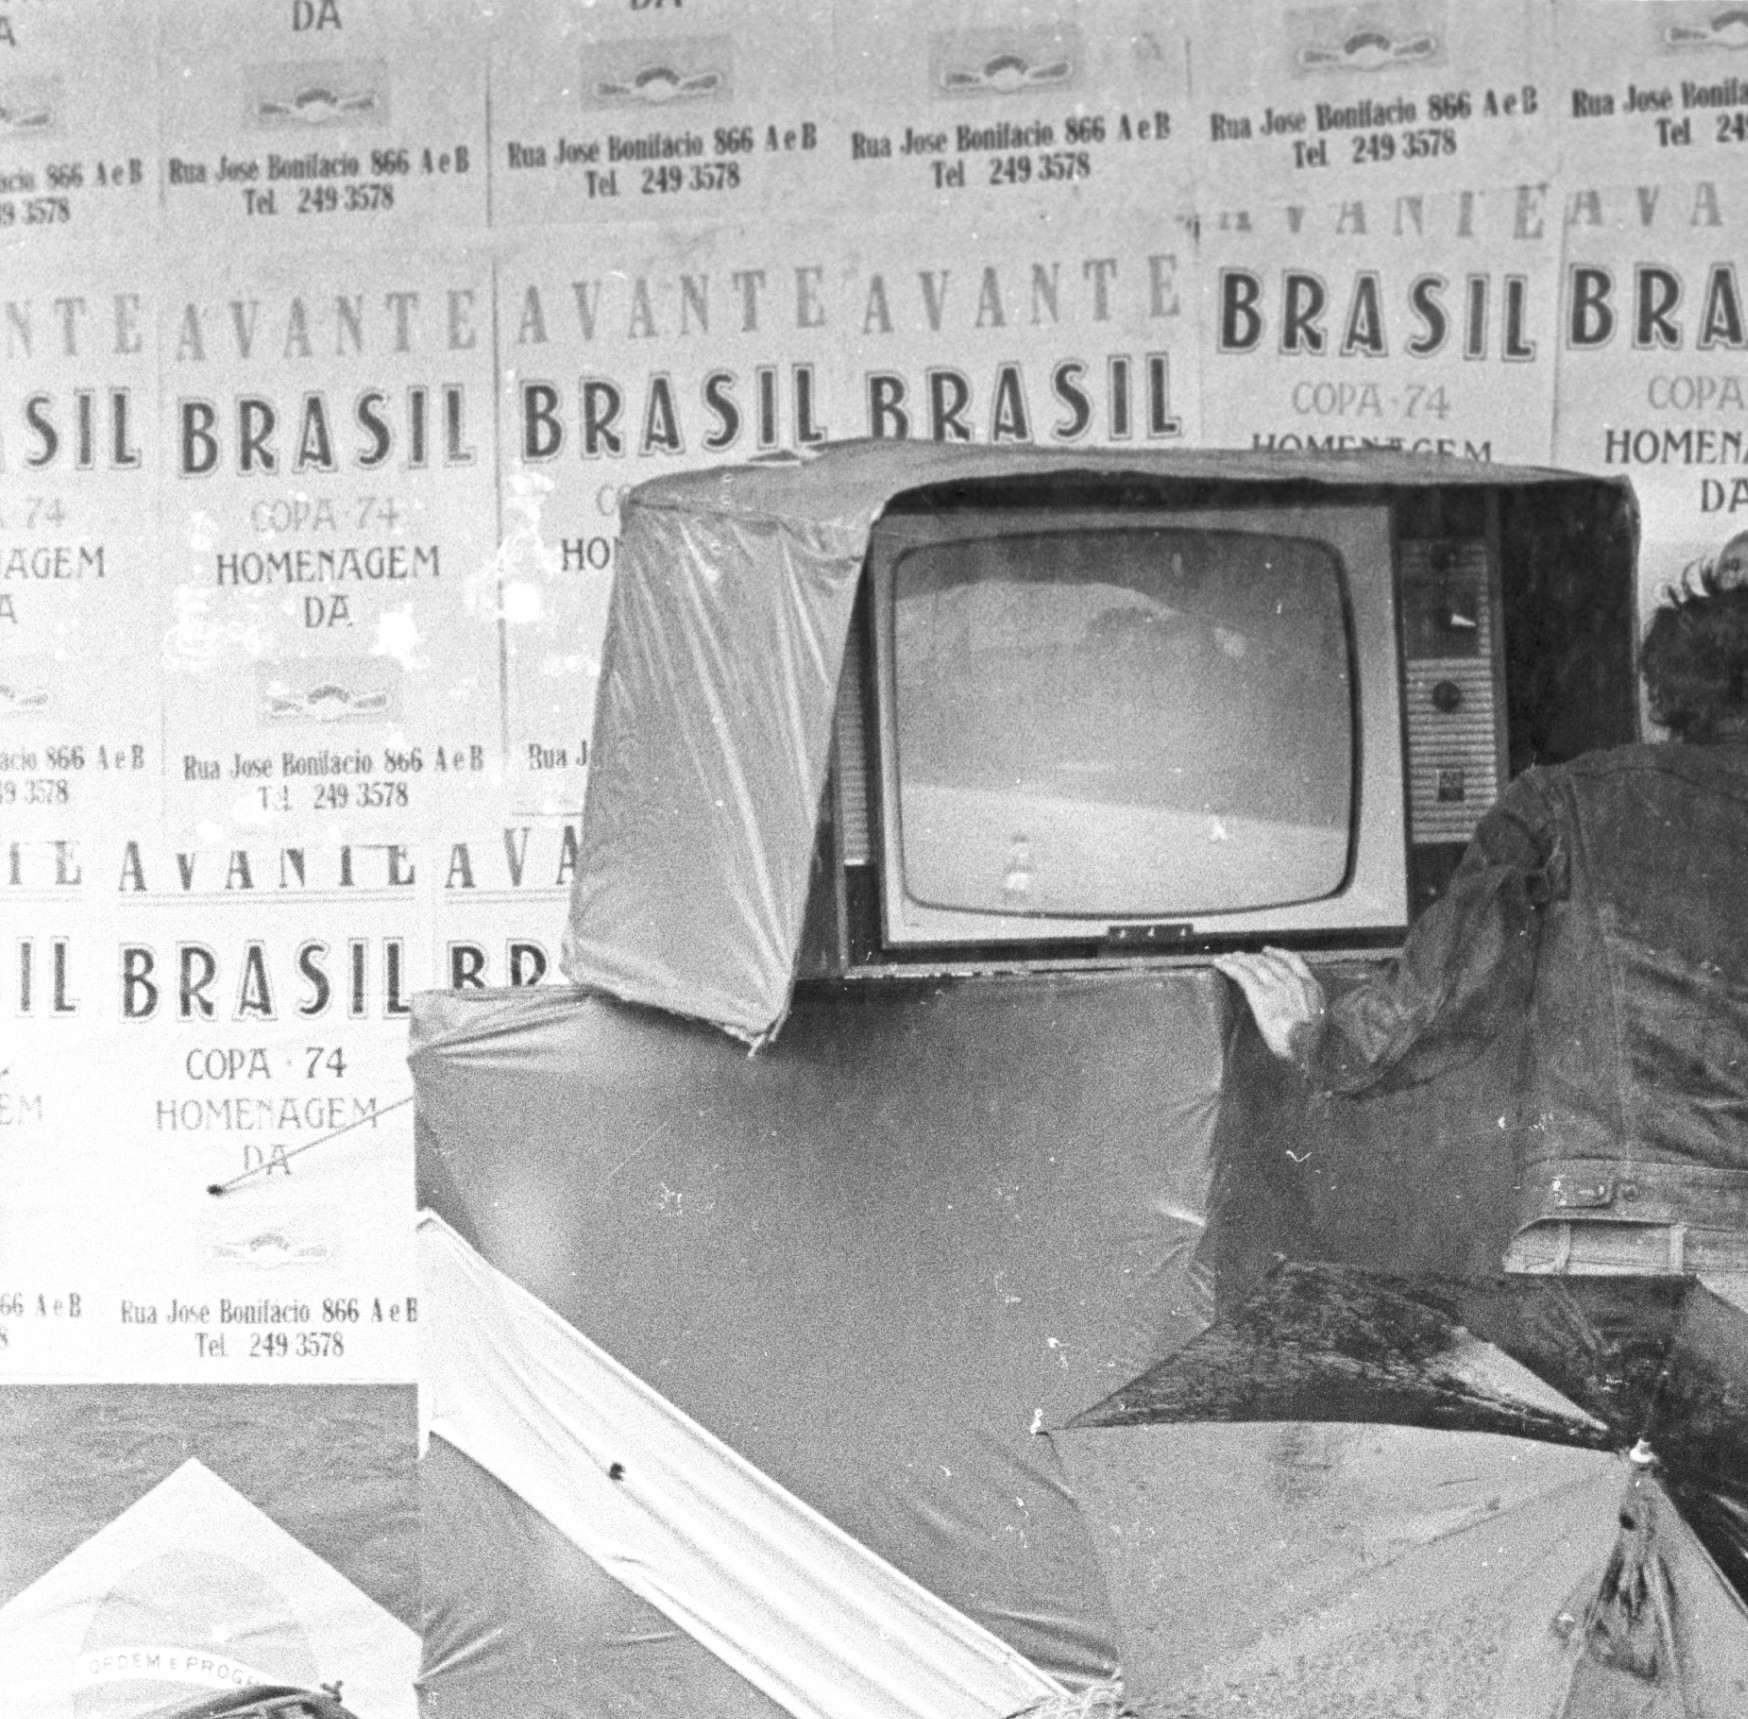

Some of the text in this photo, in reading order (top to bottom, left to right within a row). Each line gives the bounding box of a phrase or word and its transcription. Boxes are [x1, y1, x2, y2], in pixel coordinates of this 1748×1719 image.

[1571, 88, 1615, 118] Rua
[175, 284, 479, 364] AVANTE
[515, 262, 831, 347] AVANTE
[859, 250, 1184, 337] AVANTE
[1217, 266, 1536, 363] BRASIL
[20, 386, 142, 472] SIL
[177, 381, 472, 478] BRASIL
[518, 360, 831, 465] BRASIL
[861, 347, 1184, 445] BRASIL
[216, 544, 440, 586] HOMENAGEM
[304, 593, 353, 629] DA
[185, 1047, 272, 1081] COPA
[322, 1299, 360, 1322] 866
